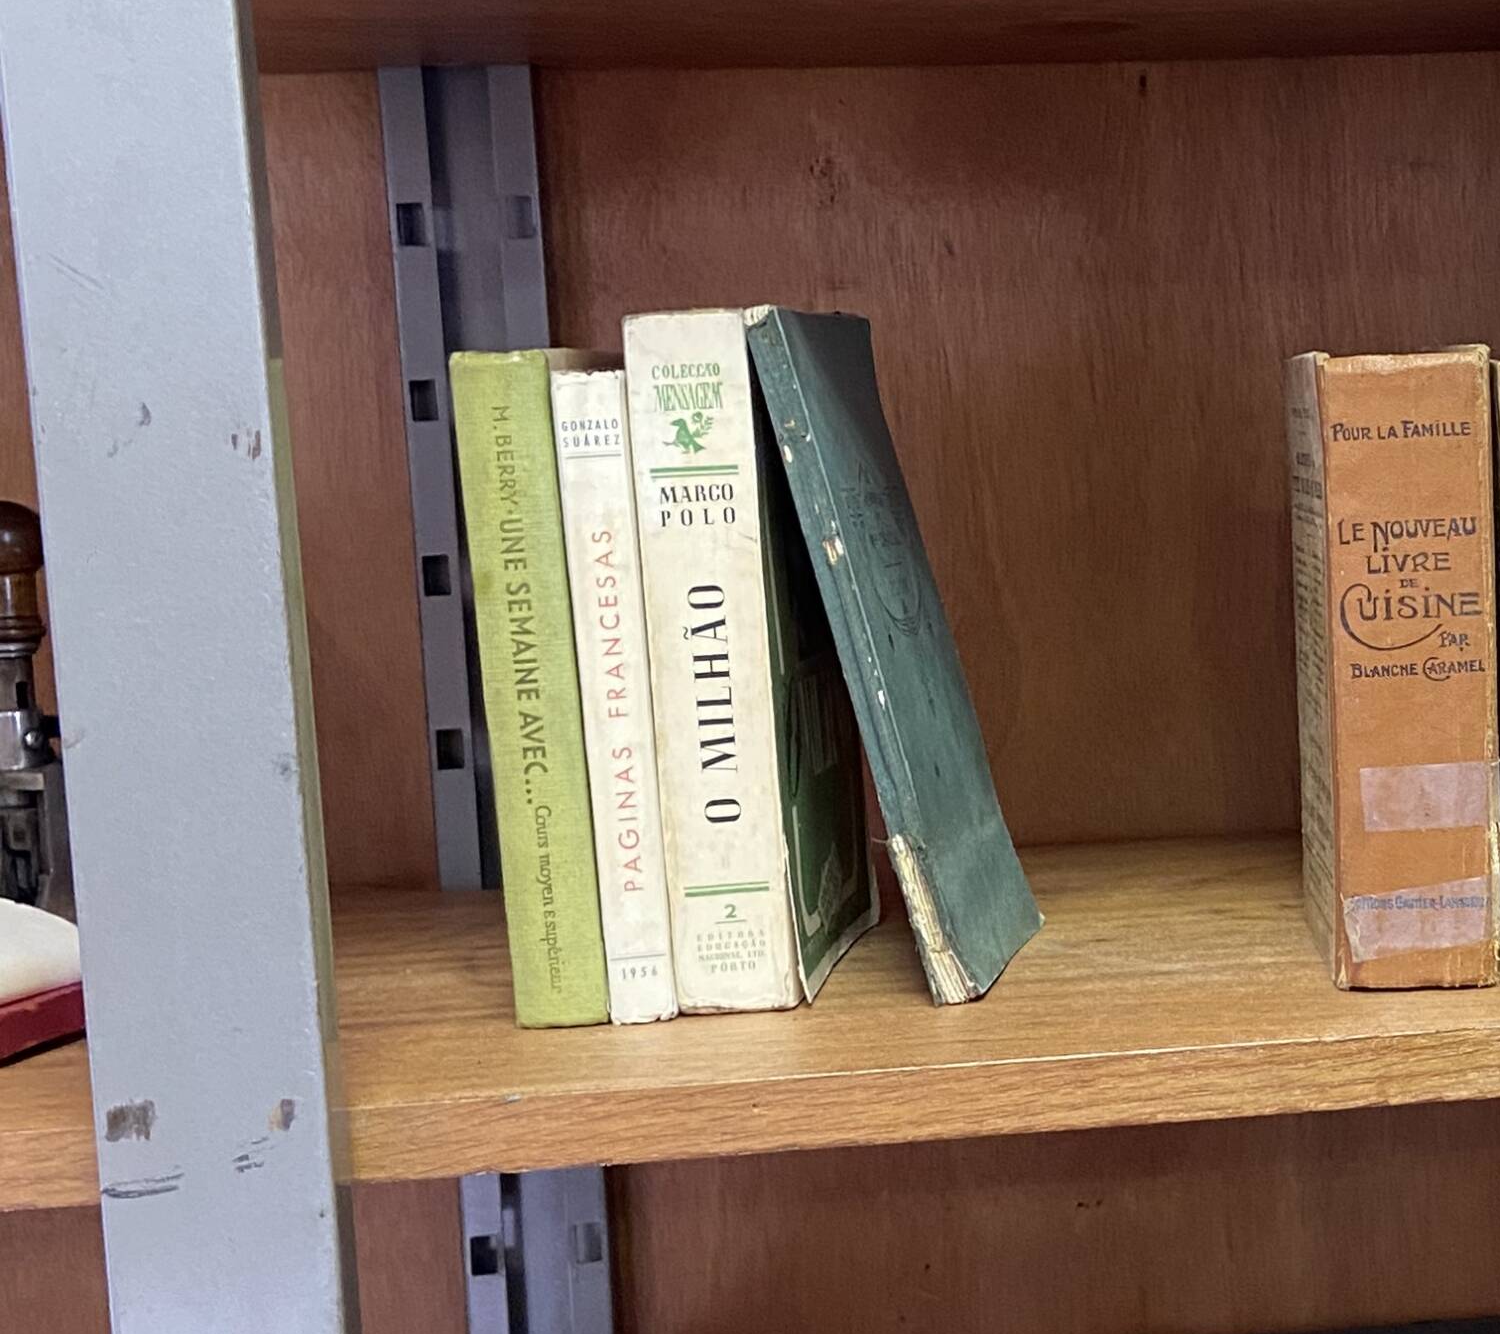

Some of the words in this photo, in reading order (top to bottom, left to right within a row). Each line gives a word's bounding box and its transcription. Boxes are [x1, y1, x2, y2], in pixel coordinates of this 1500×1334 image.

[561, 418, 619, 432] GONZALO
[1377, 425, 1399, 440] LA
[659, 483, 734, 504] MARCO
[660, 506, 736, 527] POLO
[499, 517, 528, 571] UNE
[1337, 519, 1366, 546] LE
[1370, 516, 1478, 554] NOUVEAU
[1365, 547, 1453, 575] LIVRE
[1399, 578, 1419, 589] DE
[592, 530, 629, 719] FRANCESAS
[506, 581, 541, 702] SEMAINE
[682, 584, 738, 773] MILHÃO
[1350, 663, 1419, 679] BLANCHE
[1422, 656, 1486, 682] CARAMEL
[518, 710, 549, 805] AVEC...
[611, 746, 645, 892] PAGINAS
[704, 798, 742, 824] O
[535, 804, 552, 849] Cours
[536, 853, 555, 907] moyen
[723, 904, 737, 918] 2
[621, 965, 658, 981] 1956
